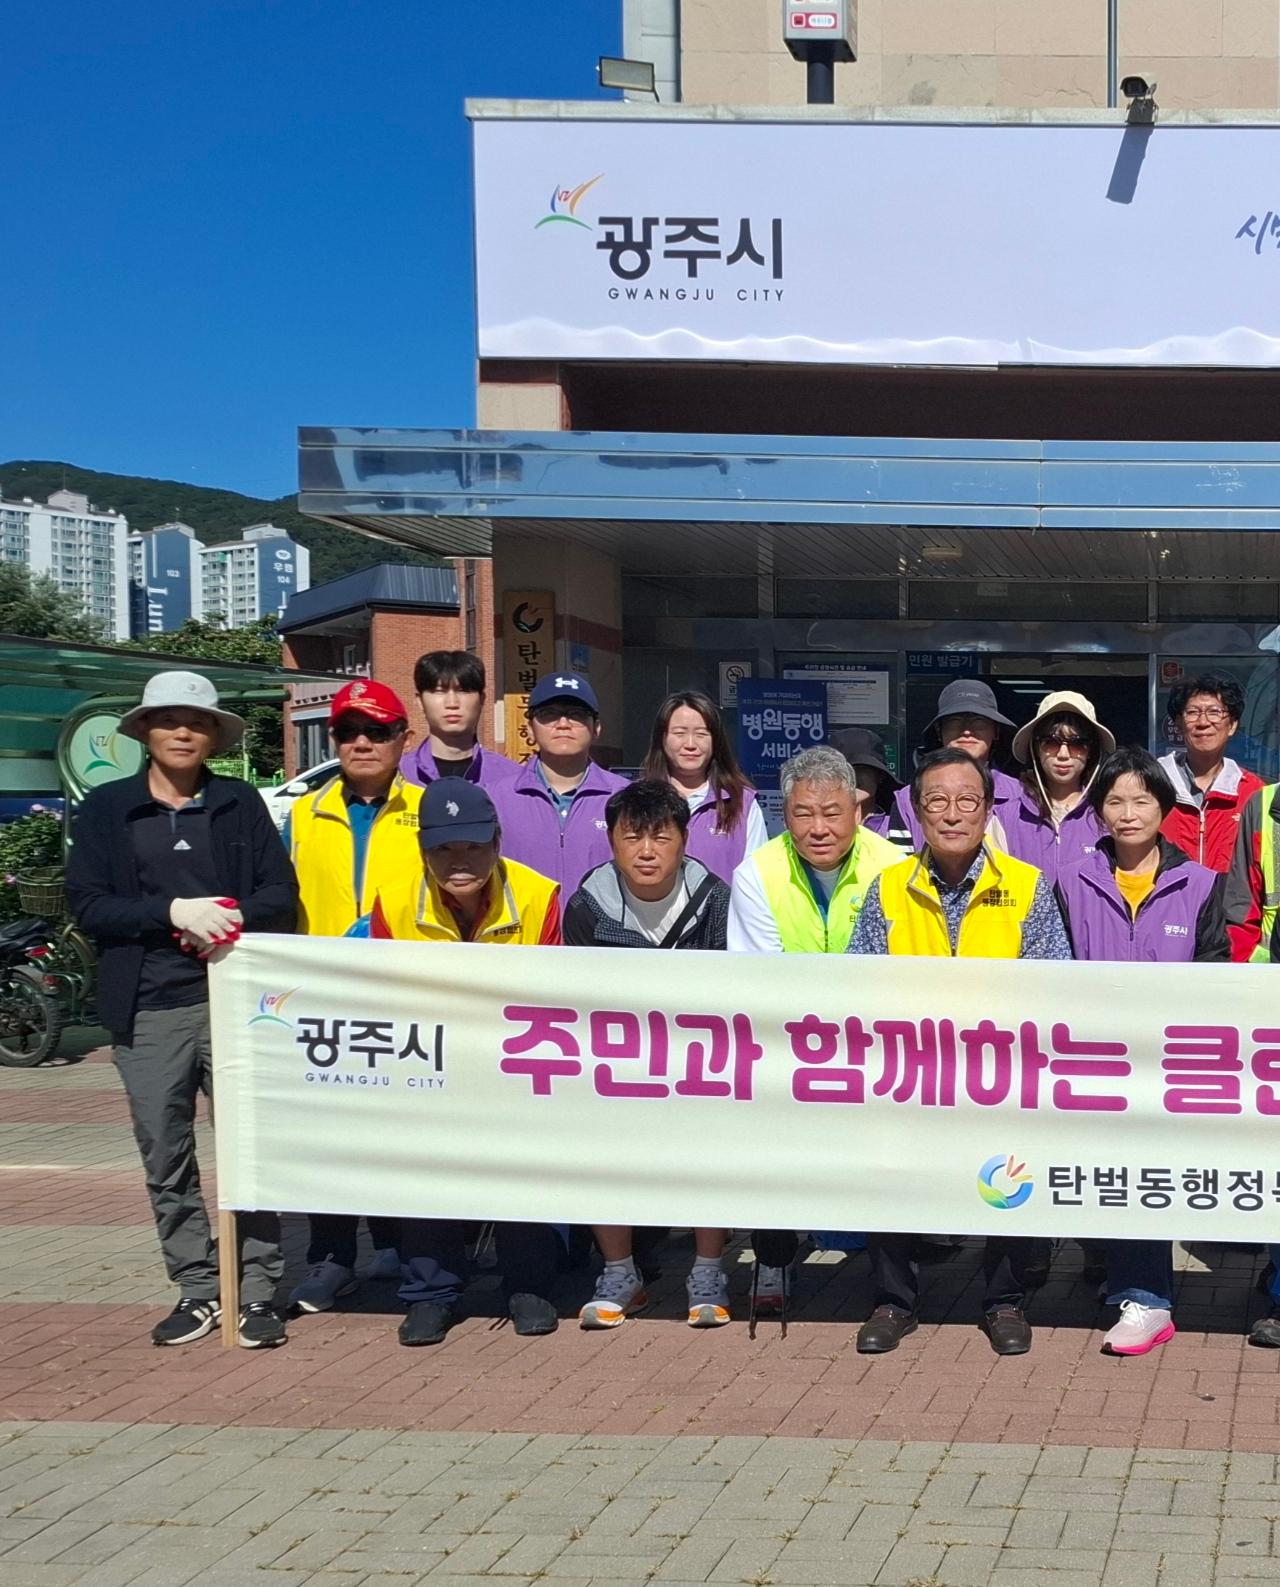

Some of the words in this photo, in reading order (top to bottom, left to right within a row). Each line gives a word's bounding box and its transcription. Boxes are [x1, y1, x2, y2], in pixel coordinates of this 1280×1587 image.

[595, 216, 783, 280] 광주시
[608, 287, 716, 301] GWANGJU
[737, 287, 785, 302] CITY
[909, 654, 932, 667] 민원
[742, 708, 824, 740] 병원동행
[1163, 924, 1188, 935] 광주시
[296, 1017, 445, 1072] 광주시
[500, 1004, 764, 1101] 주민과
[784, 1013, 1132, 1113] 함께하는
[305, 1072, 391, 1087] GWANGJU
[407, 1077, 446, 1089] CITY
